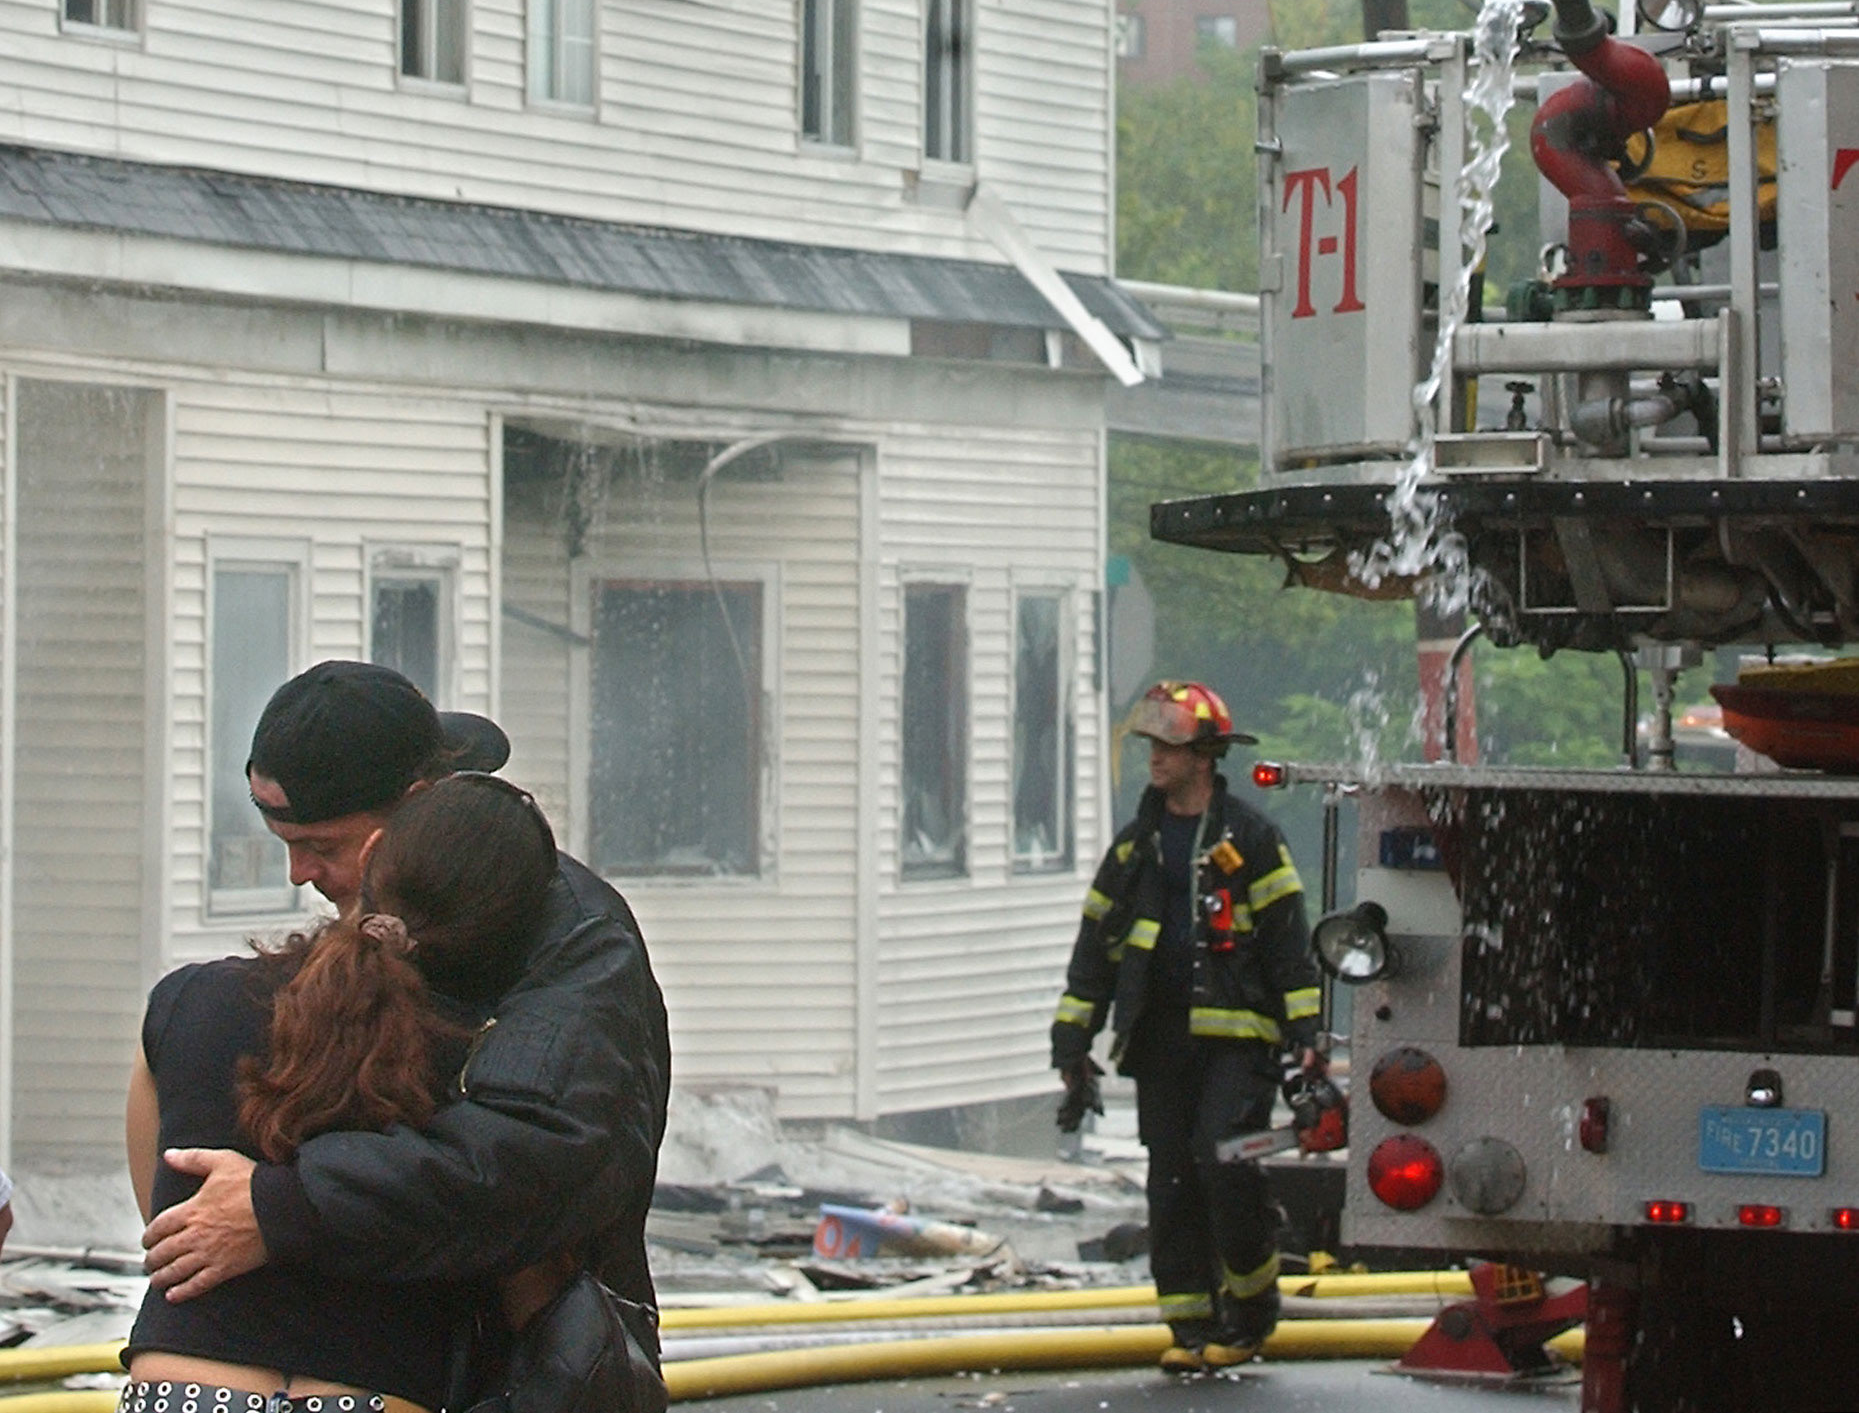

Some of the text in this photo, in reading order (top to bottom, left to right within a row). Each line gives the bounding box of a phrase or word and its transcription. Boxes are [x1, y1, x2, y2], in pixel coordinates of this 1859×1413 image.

[1282, 165, 1366, 319] T-1
[1706, 1120, 1816, 1160] FIRE 7340
